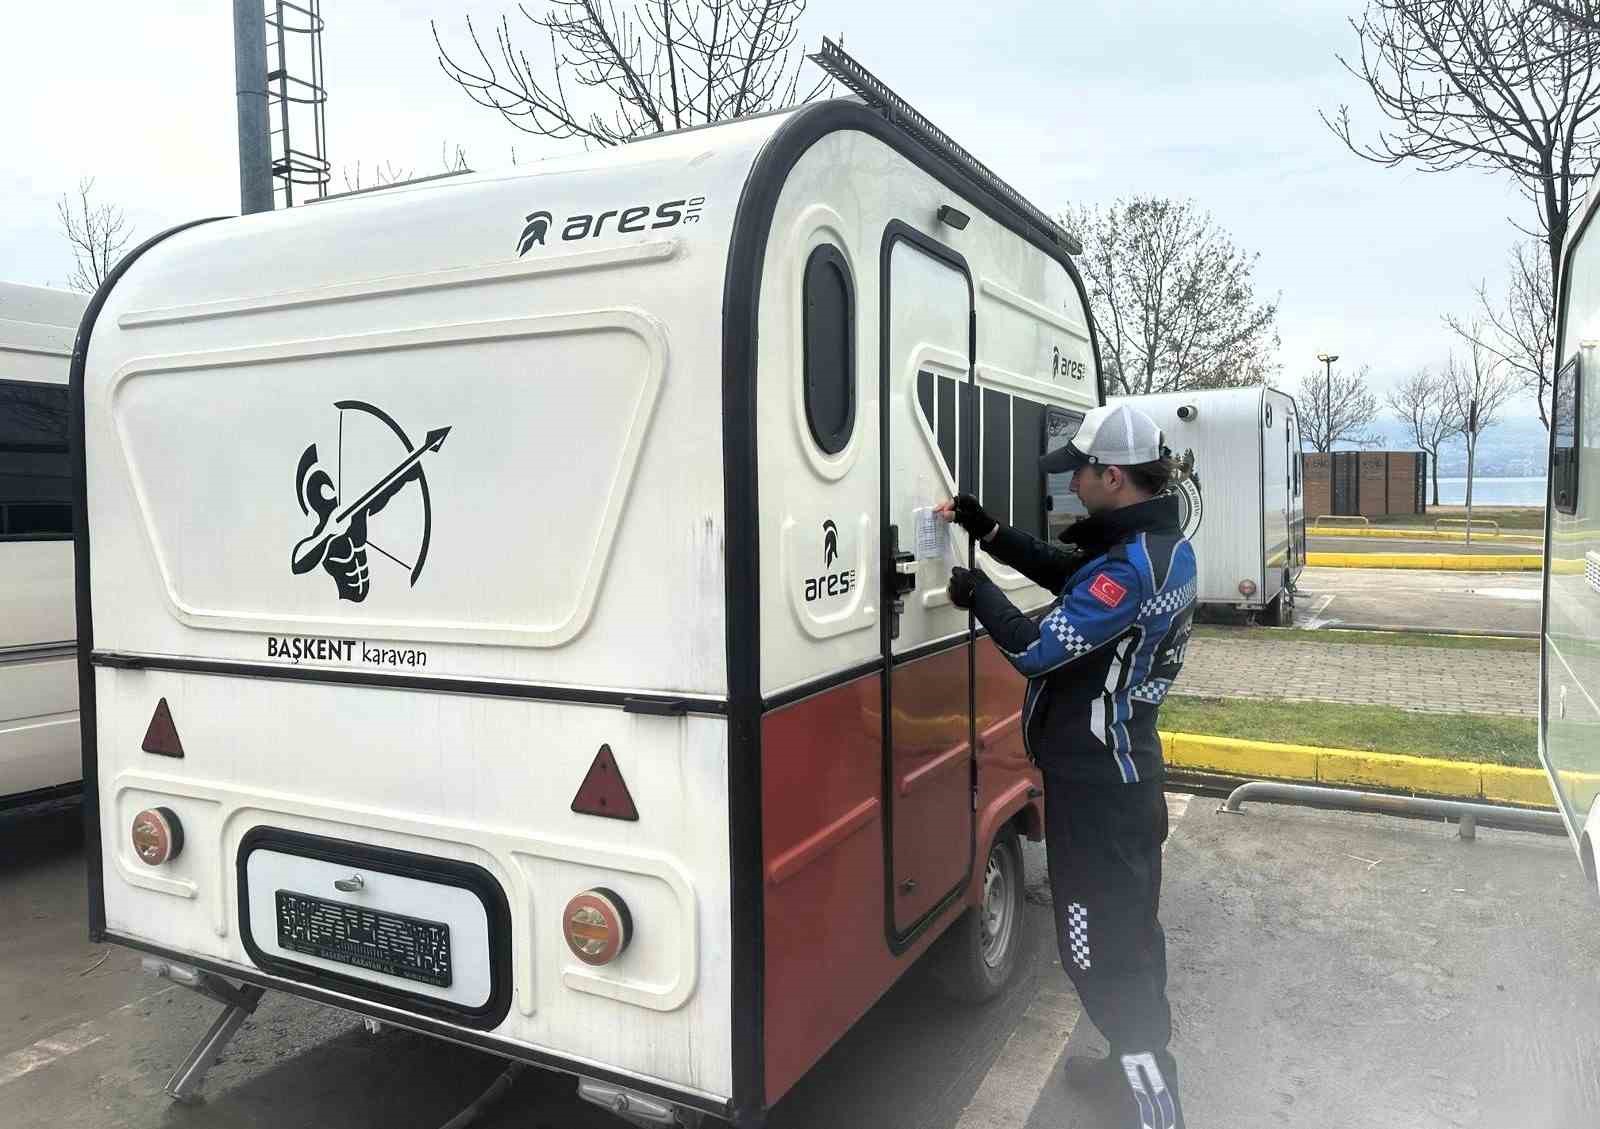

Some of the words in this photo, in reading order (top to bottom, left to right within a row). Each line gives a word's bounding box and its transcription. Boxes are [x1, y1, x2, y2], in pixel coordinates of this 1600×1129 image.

[562, 200, 686, 241] ares
[683, 196, 706, 225] 310
[1061, 357, 1083, 380] ares
[804, 570, 850, 602] ares
[267, 637, 356, 665] BAŞKENT
[362, 641, 427, 667] karavan
